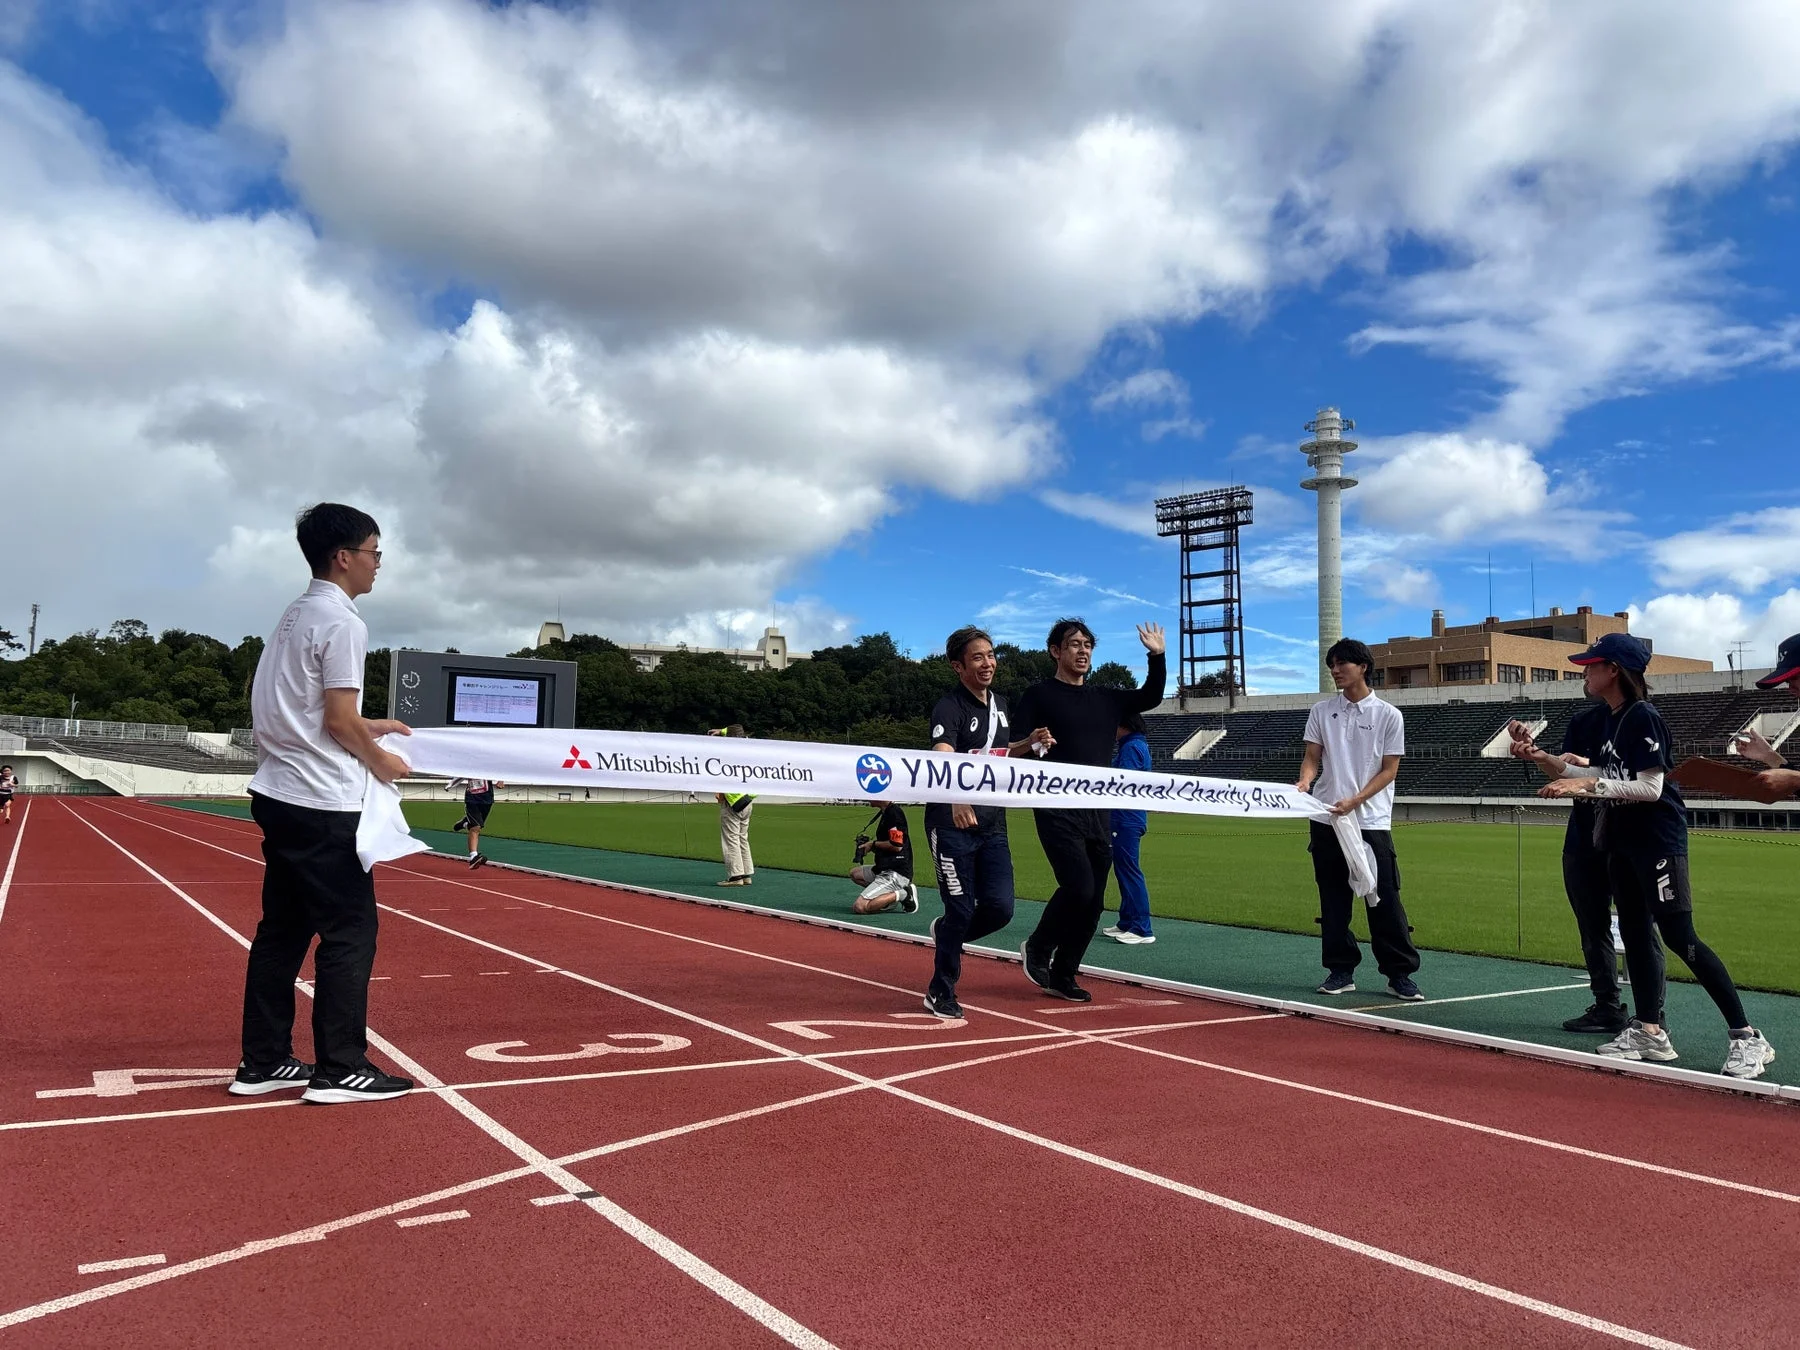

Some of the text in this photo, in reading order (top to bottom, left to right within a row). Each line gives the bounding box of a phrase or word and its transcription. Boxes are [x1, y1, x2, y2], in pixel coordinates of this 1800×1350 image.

[595, 752, 814, 783] Mitsubishi Corporation
[900, 757, 1292, 812] YMCA International Charity Run
[940, 852, 964, 896] JAPAN
[464, 1033, 692, 1063] 3
